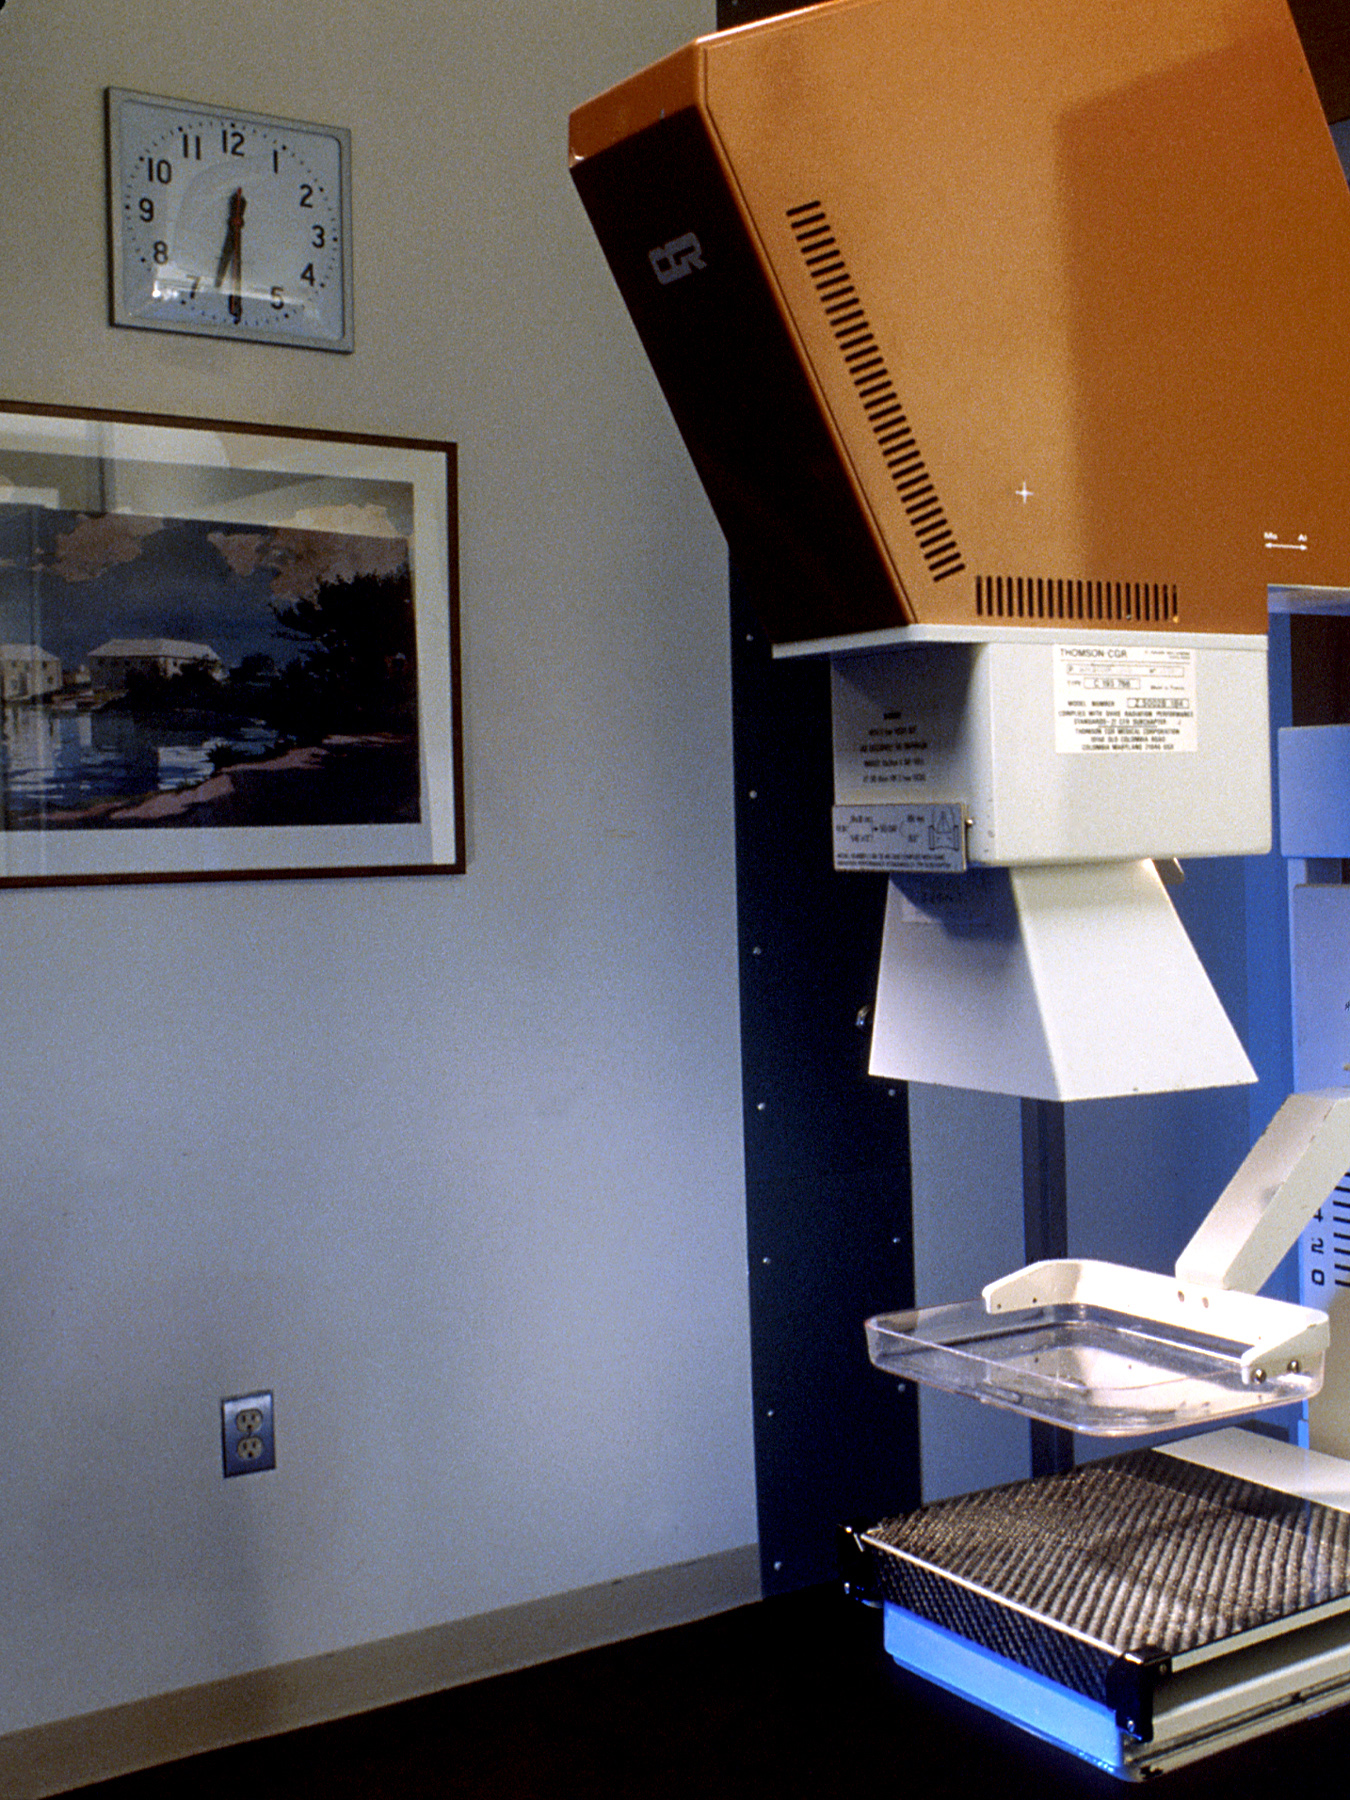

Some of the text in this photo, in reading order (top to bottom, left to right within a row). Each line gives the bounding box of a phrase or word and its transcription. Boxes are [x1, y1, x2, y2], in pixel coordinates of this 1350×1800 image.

[183, 134, 200, 160] 11
[222, 130, 245, 157] 12
[148, 158, 172, 184] 10
[273, 150, 278, 173] 1
[300, 184, 314, 208] 2
[139, 197, 154, 222] 9
[311, 224, 325, 248] 3
[153, 240, 168, 265] 8
[301, 263, 315, 286] 4
[270, 286, 284, 310] 5
[1060, 648, 1127, 658] THOMSON CGR
[1311, 1237, 1324, 1254] 2
[1311, 1269, 1325, 1286] 0
